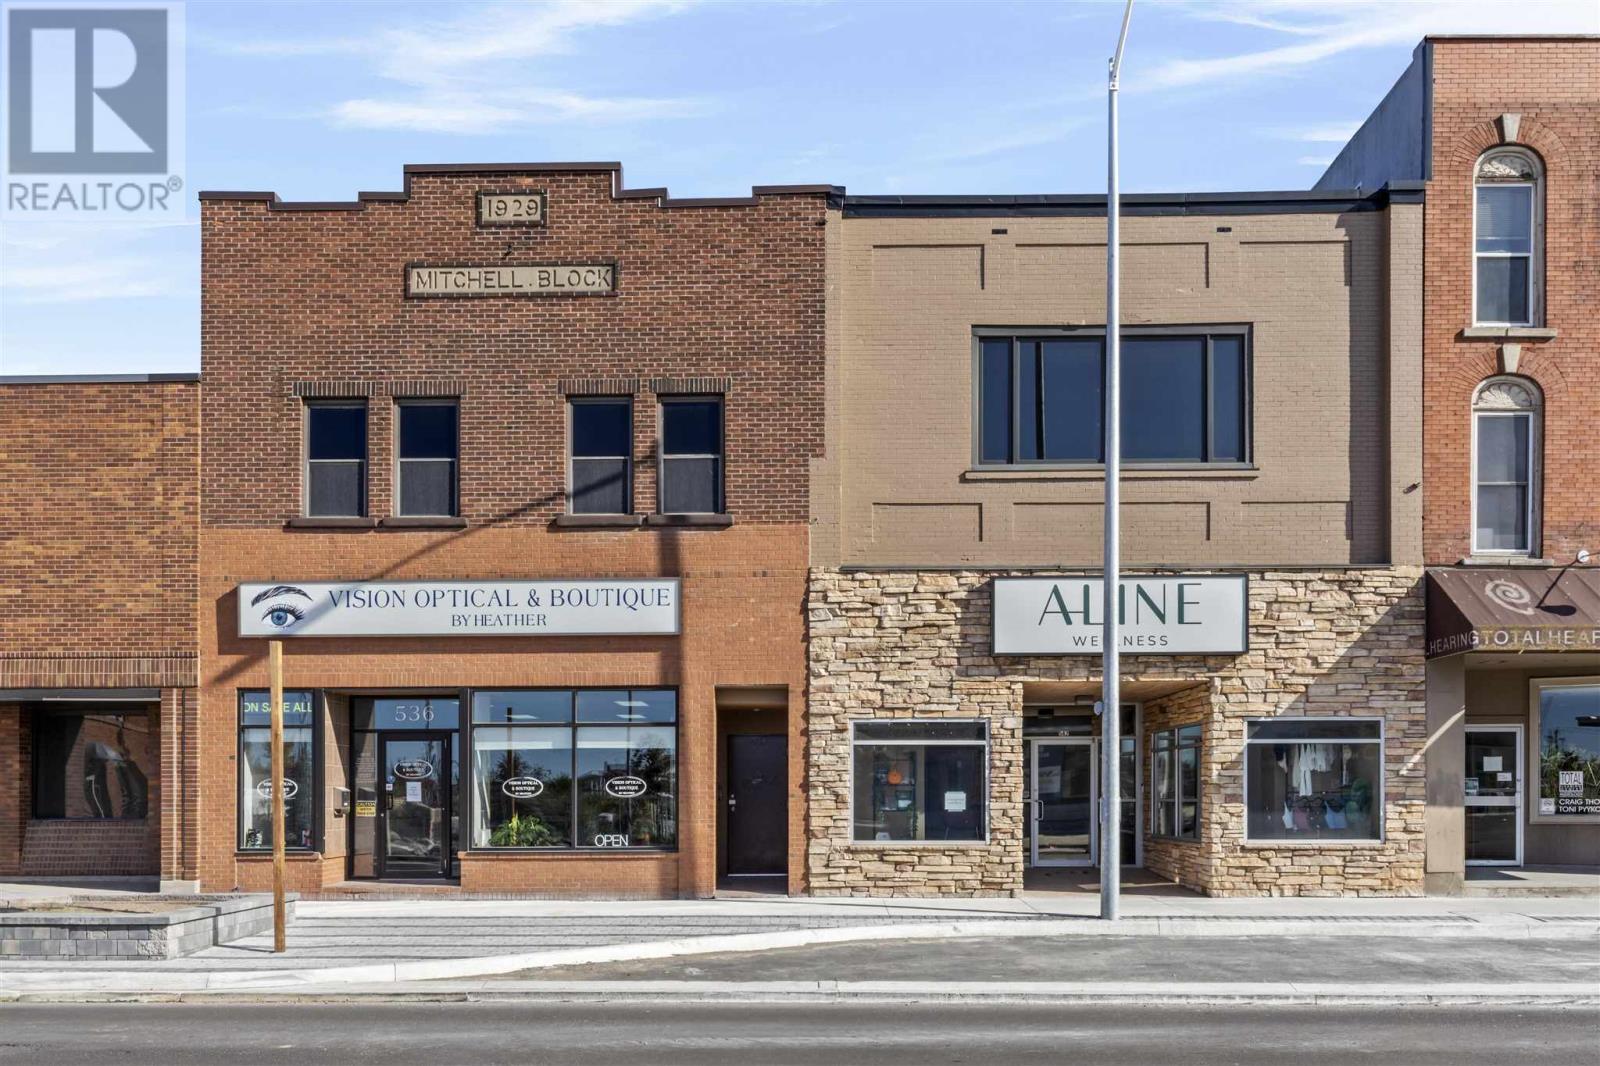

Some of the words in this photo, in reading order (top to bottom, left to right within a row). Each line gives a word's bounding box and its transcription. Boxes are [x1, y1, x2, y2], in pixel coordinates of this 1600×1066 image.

[487, 199, 540, 218] 1929
[537, 269, 612, 289] BLOCK
[328, 589, 407, 609] VISION
[414, 588, 519, 609] OPTICAL
[527, 588, 542, 608] &
[550, 587, 671, 611] BOUTIQUE
[451, 614, 472, 628] BY
[474, 613, 547, 627] HEATHER
[1072, 635, 1169, 647] WENESS
[262, 702, 291, 713] SE
[293, 702, 313, 713] ALL
[394, 705, 435, 722] 536
[1560, 772, 1583, 785] TOTAL
[595, 834, 629, 847] OPEN
